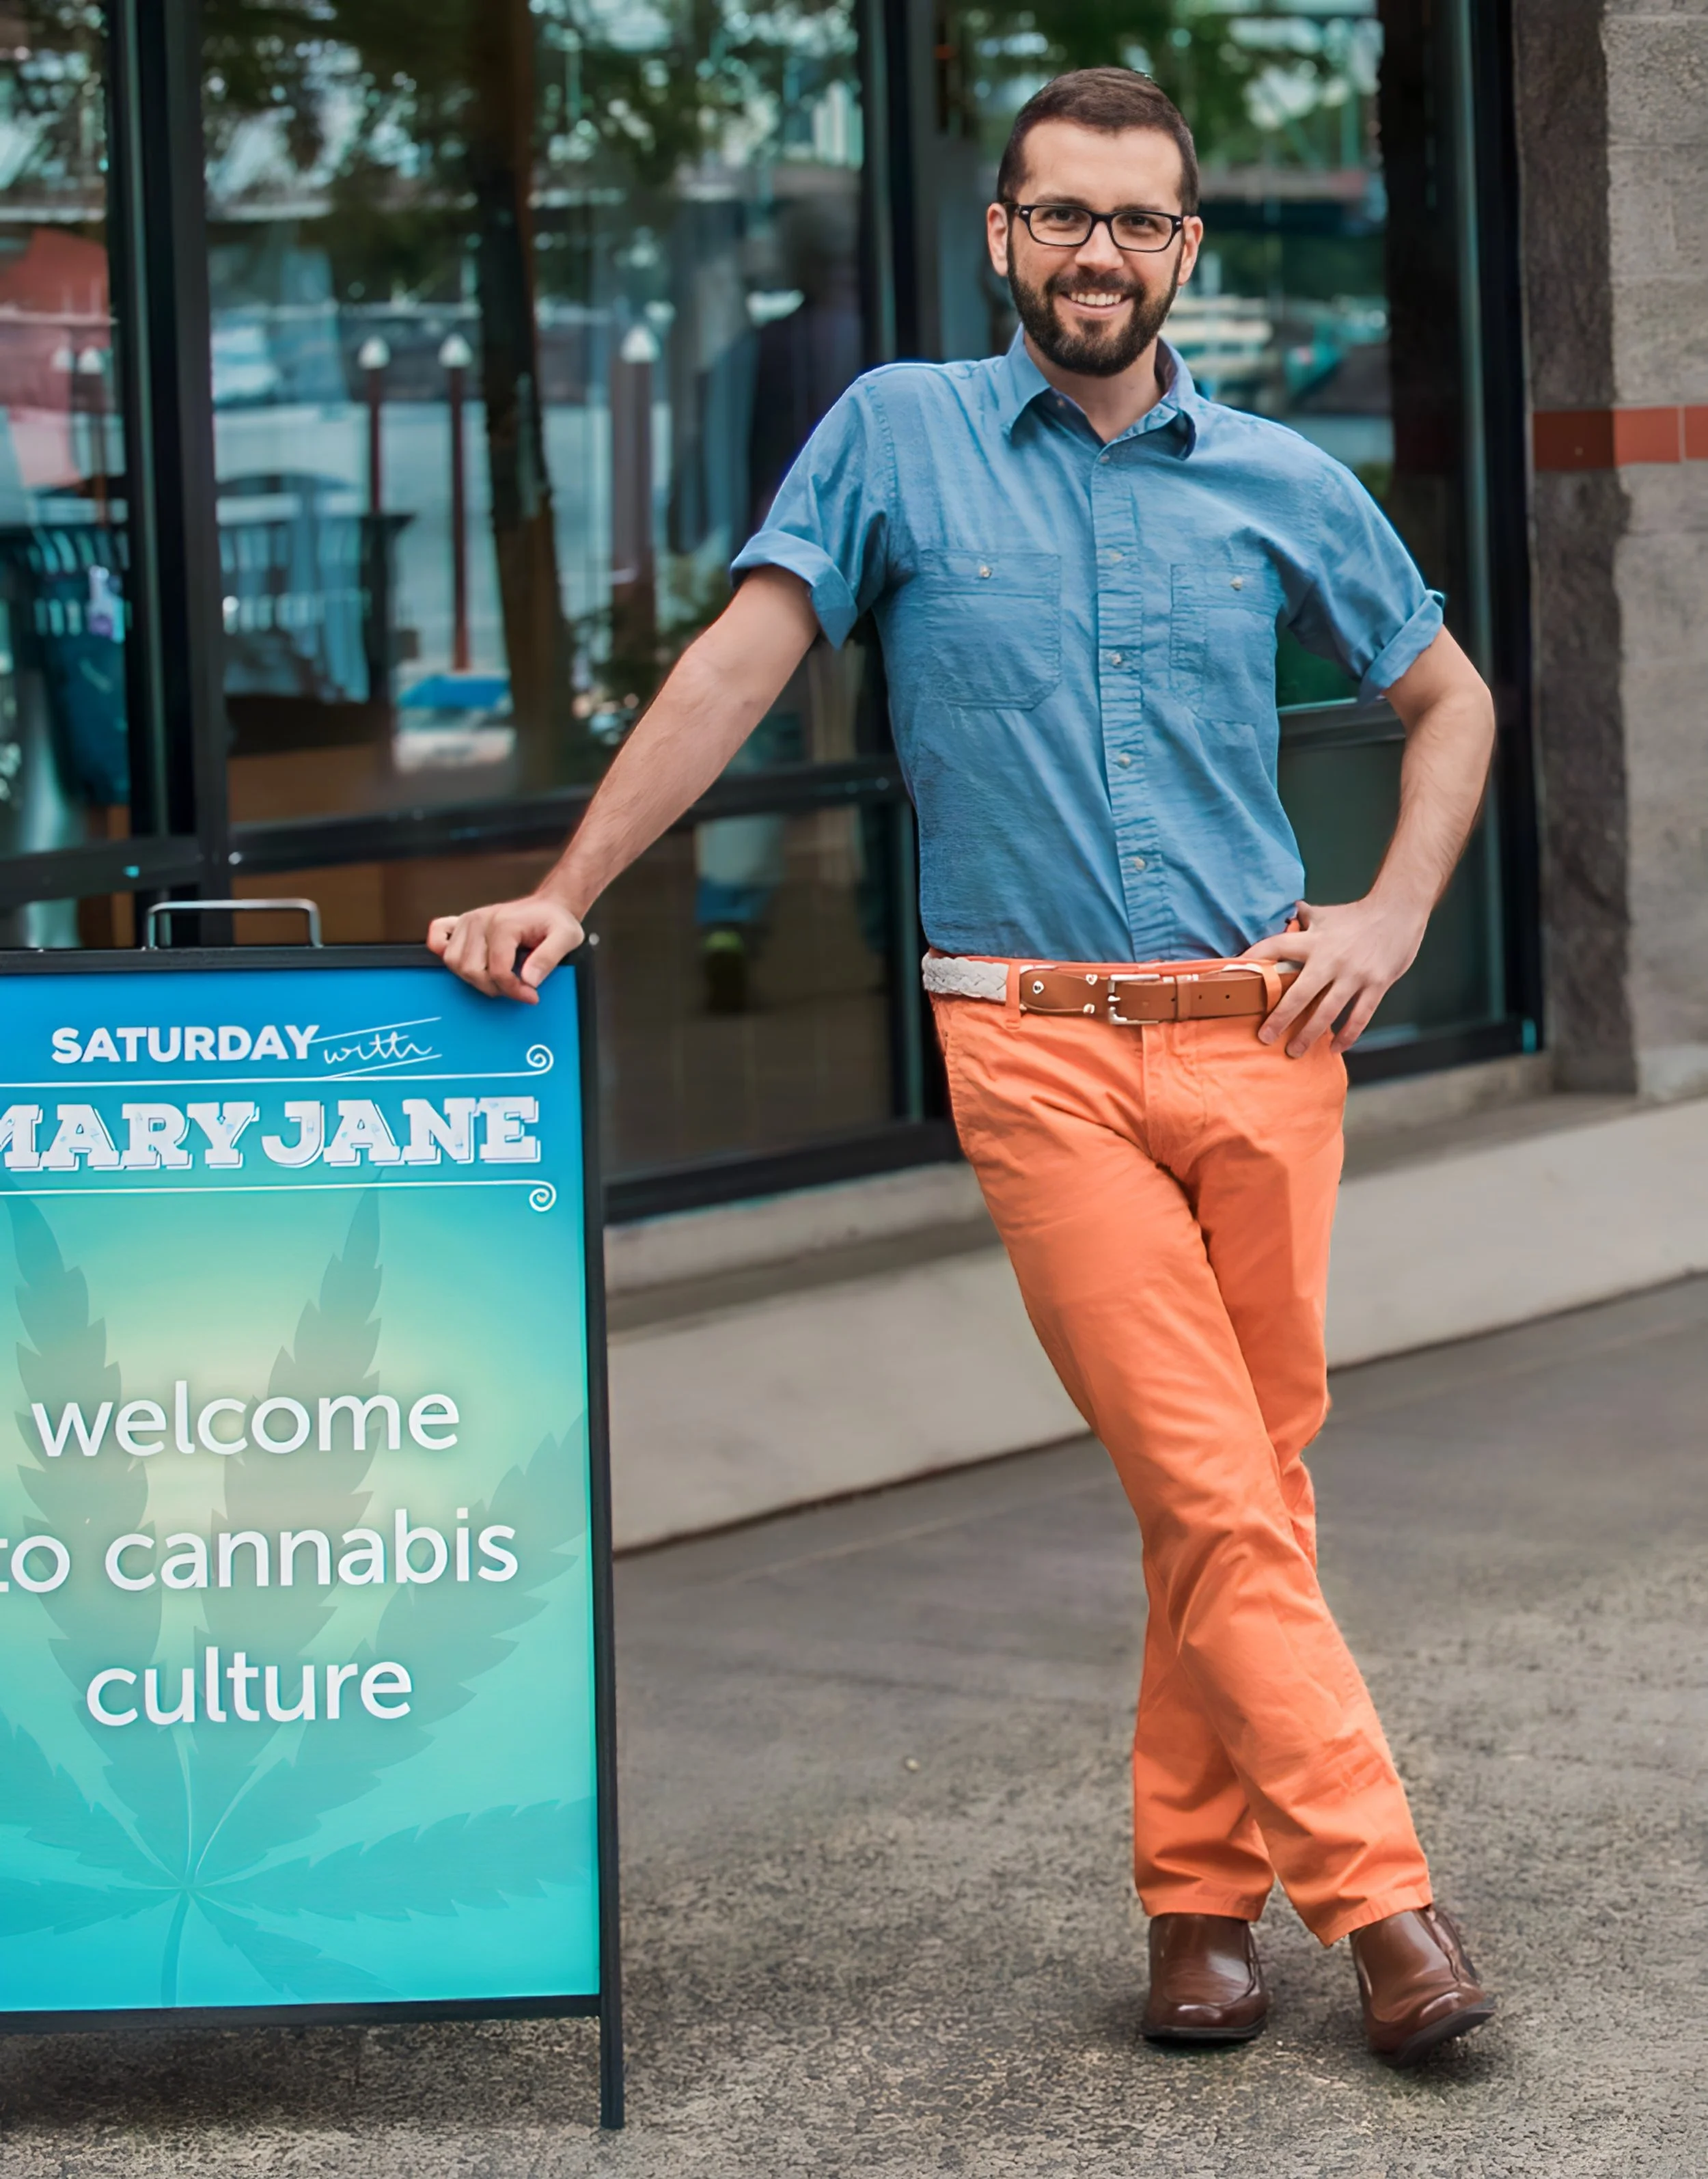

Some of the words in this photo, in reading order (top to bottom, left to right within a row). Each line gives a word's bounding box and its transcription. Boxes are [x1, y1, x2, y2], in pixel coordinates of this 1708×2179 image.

[51, 1025, 320, 1064] SATURDAY
[324, 1031, 432, 1064] with
[262, 1096, 542, 1168] JANE
[31, 1380, 459, 1457] welcome
[105, 1508, 519, 1591] cannabis
[87, 1647, 412, 1726] culture
